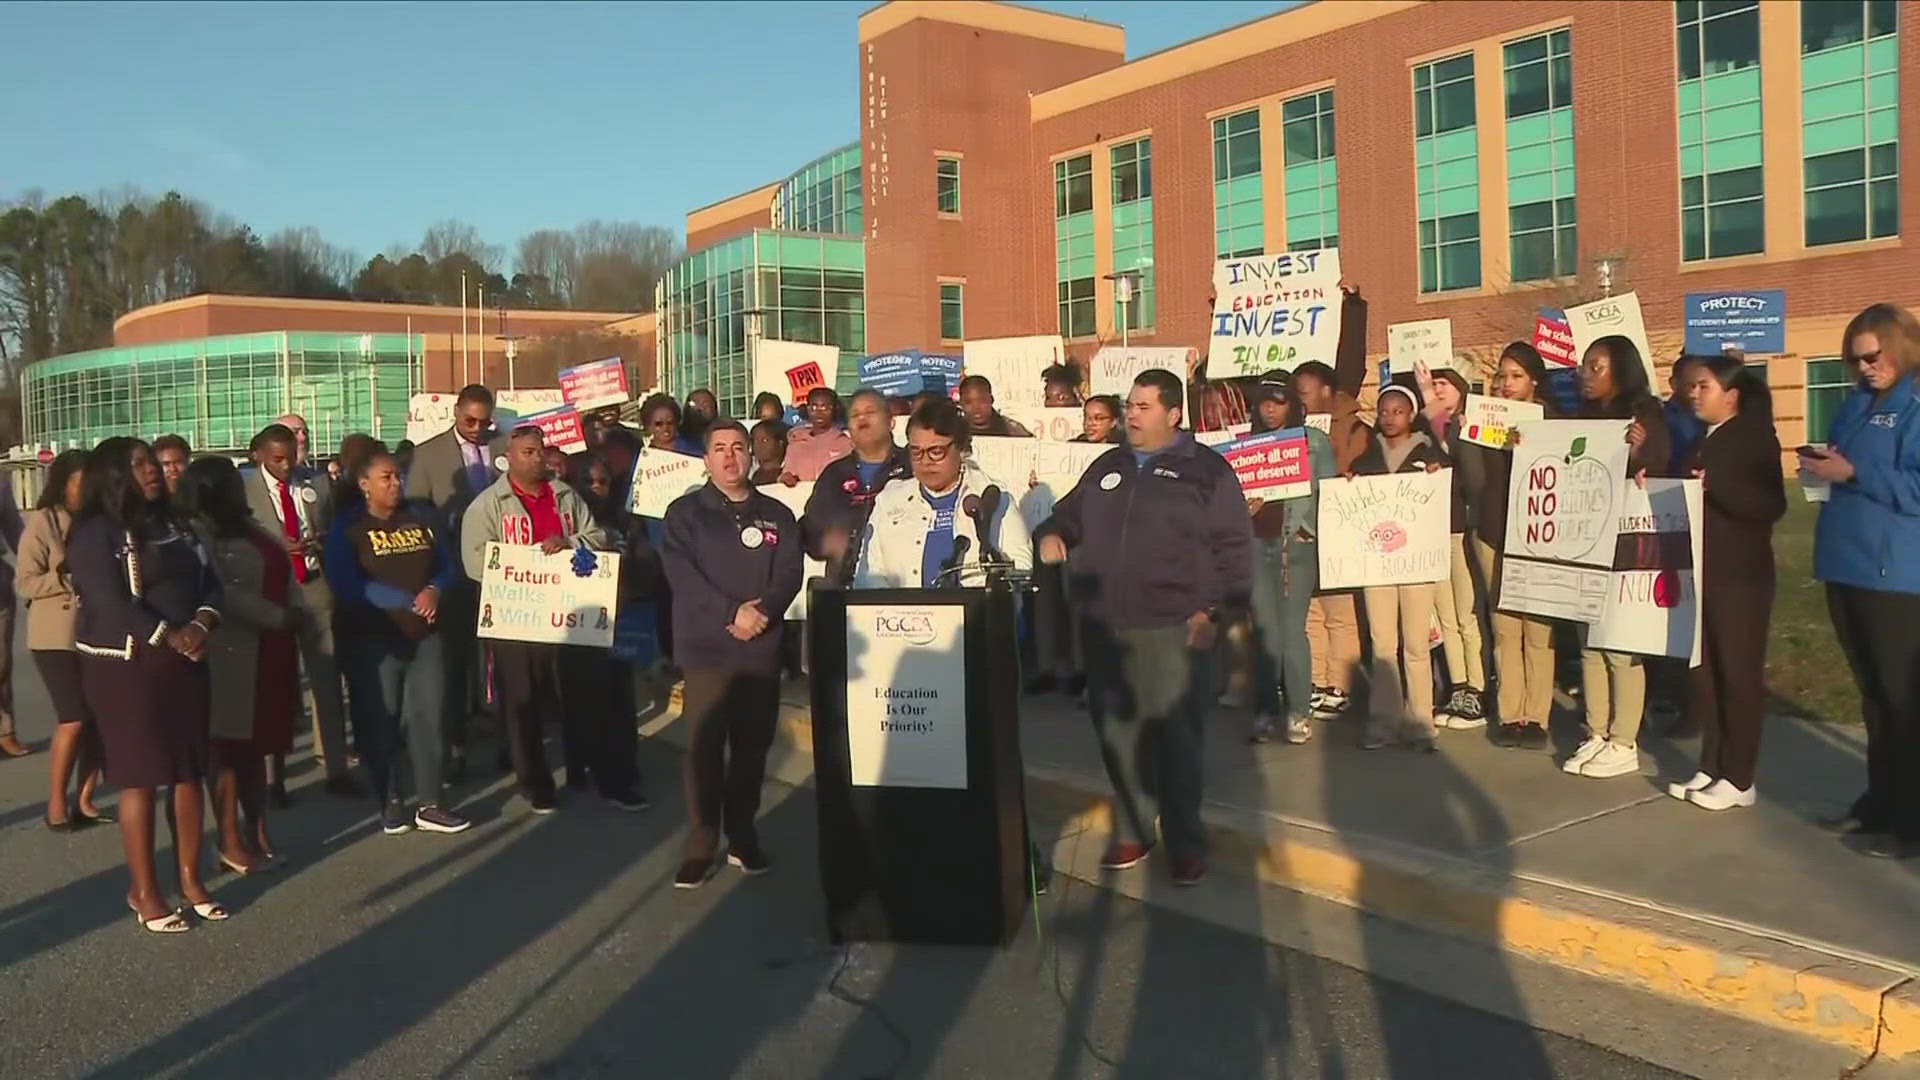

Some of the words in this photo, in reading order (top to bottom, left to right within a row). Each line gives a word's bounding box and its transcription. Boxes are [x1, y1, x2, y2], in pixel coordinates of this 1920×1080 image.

[1225, 252, 1321, 285] INVEST
[1264, 278, 1283, 290] in
[1233, 288, 1324, 312] EDUCATION
[1700, 296, 1768, 312] PROTECT
[1213, 305, 1327, 338] INVEST
[1538, 323, 1553, 339] The
[1233, 344, 1260, 364] IN
[1536, 340, 1569, 360] children
[920, 357, 956, 369] ROTECT
[797, 366, 818, 387] PAY
[532, 390, 561, 402] WAL
[1231, 451, 1266, 469] schools
[1267, 448, 1282, 464] all
[1282, 447, 1300, 460] our
[645, 460, 690, 480] Future
[1256, 461, 1301, 480] deserve!
[1529, 465, 1557, 491] NO
[1396, 479, 1436, 505] Need
[1527, 492, 1557, 517] NO
[1526, 520, 1556, 545] NO
[1618, 514, 1659, 531] TUDENT
[504, 566, 561, 585] Future
[489, 584, 545, 604] Walks
[499, 606, 543, 627] With
[551, 612, 584, 628] US!
[876, 617, 933, 632] PGCEA
[874, 687, 938, 700] Education
[886, 704, 898, 716] Is
[901, 704, 928, 716] Our
[880, 720, 934, 735] Priority!
